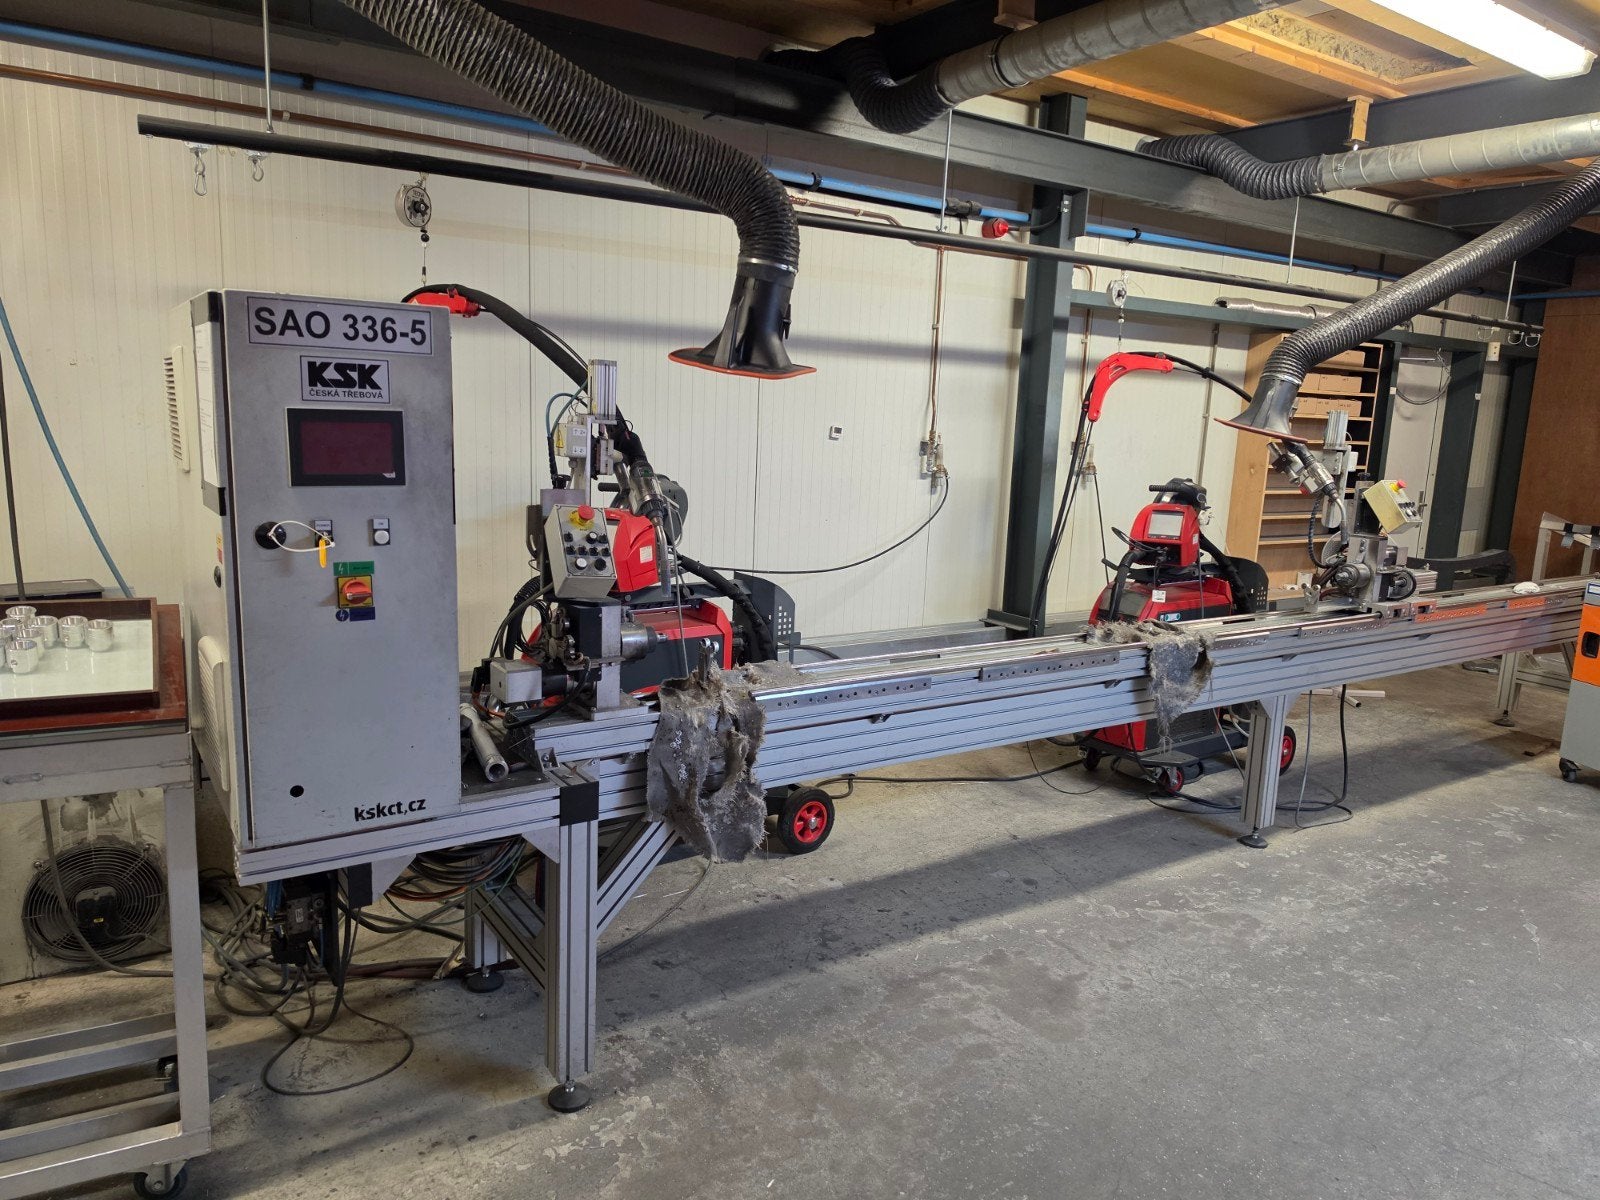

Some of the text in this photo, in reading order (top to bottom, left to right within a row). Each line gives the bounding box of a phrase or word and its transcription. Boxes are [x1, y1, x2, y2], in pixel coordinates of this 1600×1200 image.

[254, 306, 427, 346] SAO 336-5
[307, 361, 382, 390] KSK
[309, 388, 383, 399] ČESKÁ TŘEBOVÁ
